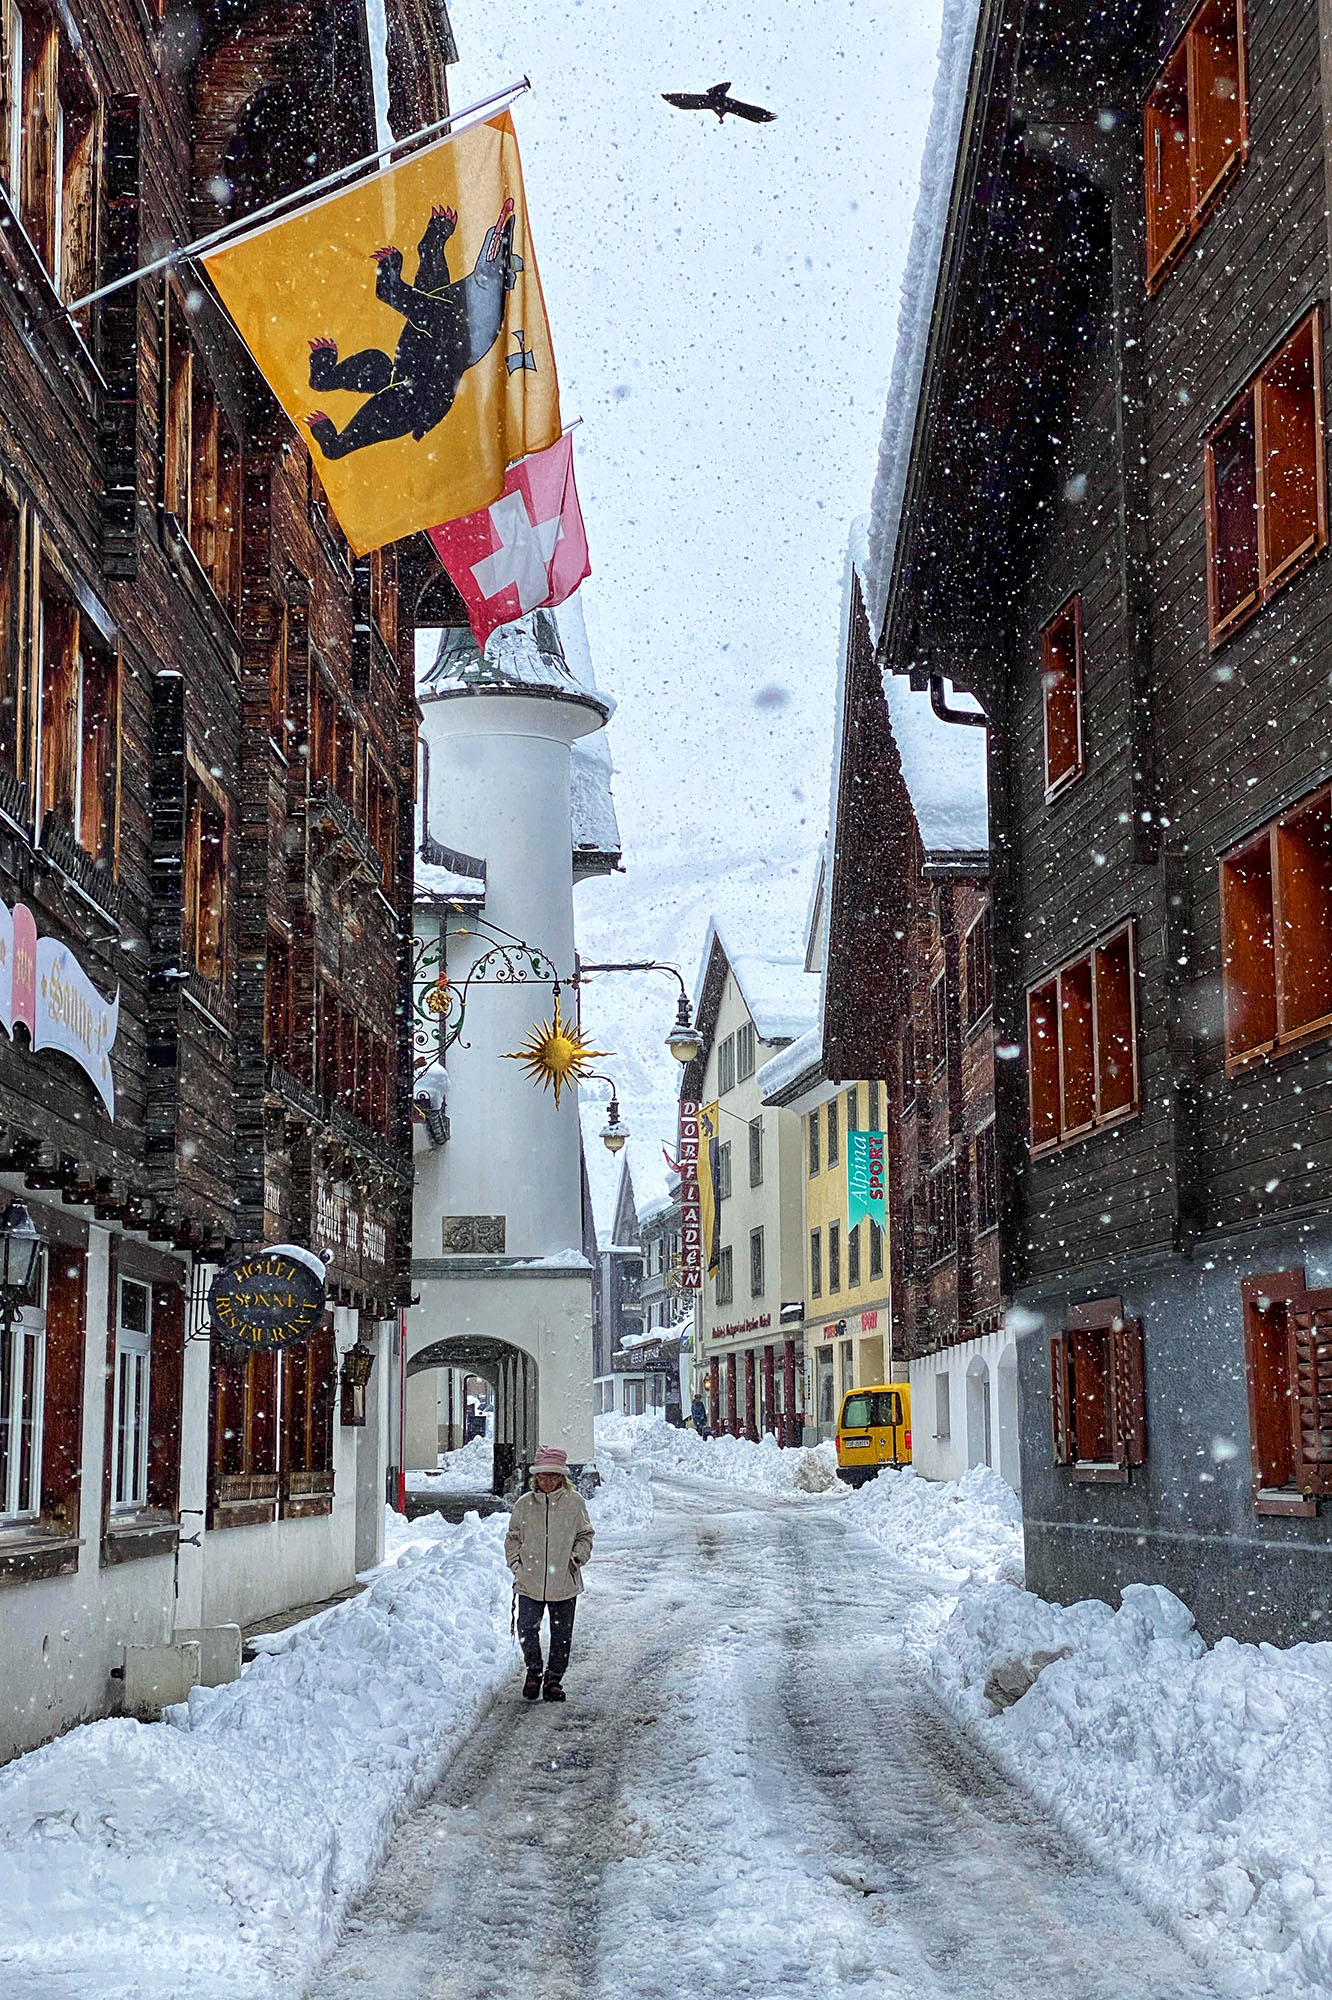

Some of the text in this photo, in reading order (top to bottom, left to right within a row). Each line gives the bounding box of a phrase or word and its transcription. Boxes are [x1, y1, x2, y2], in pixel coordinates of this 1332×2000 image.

[683, 1101, 699, 1286] DORFLADEN
[850, 1135, 867, 1205] Alpina
[869, 1136, 884, 1200] SPORT
[233, 1260, 297, 1283] HOTEL
[215, 1296, 318, 1342] RESTAURANT
[234, 1293, 298, 1308] SONNE
